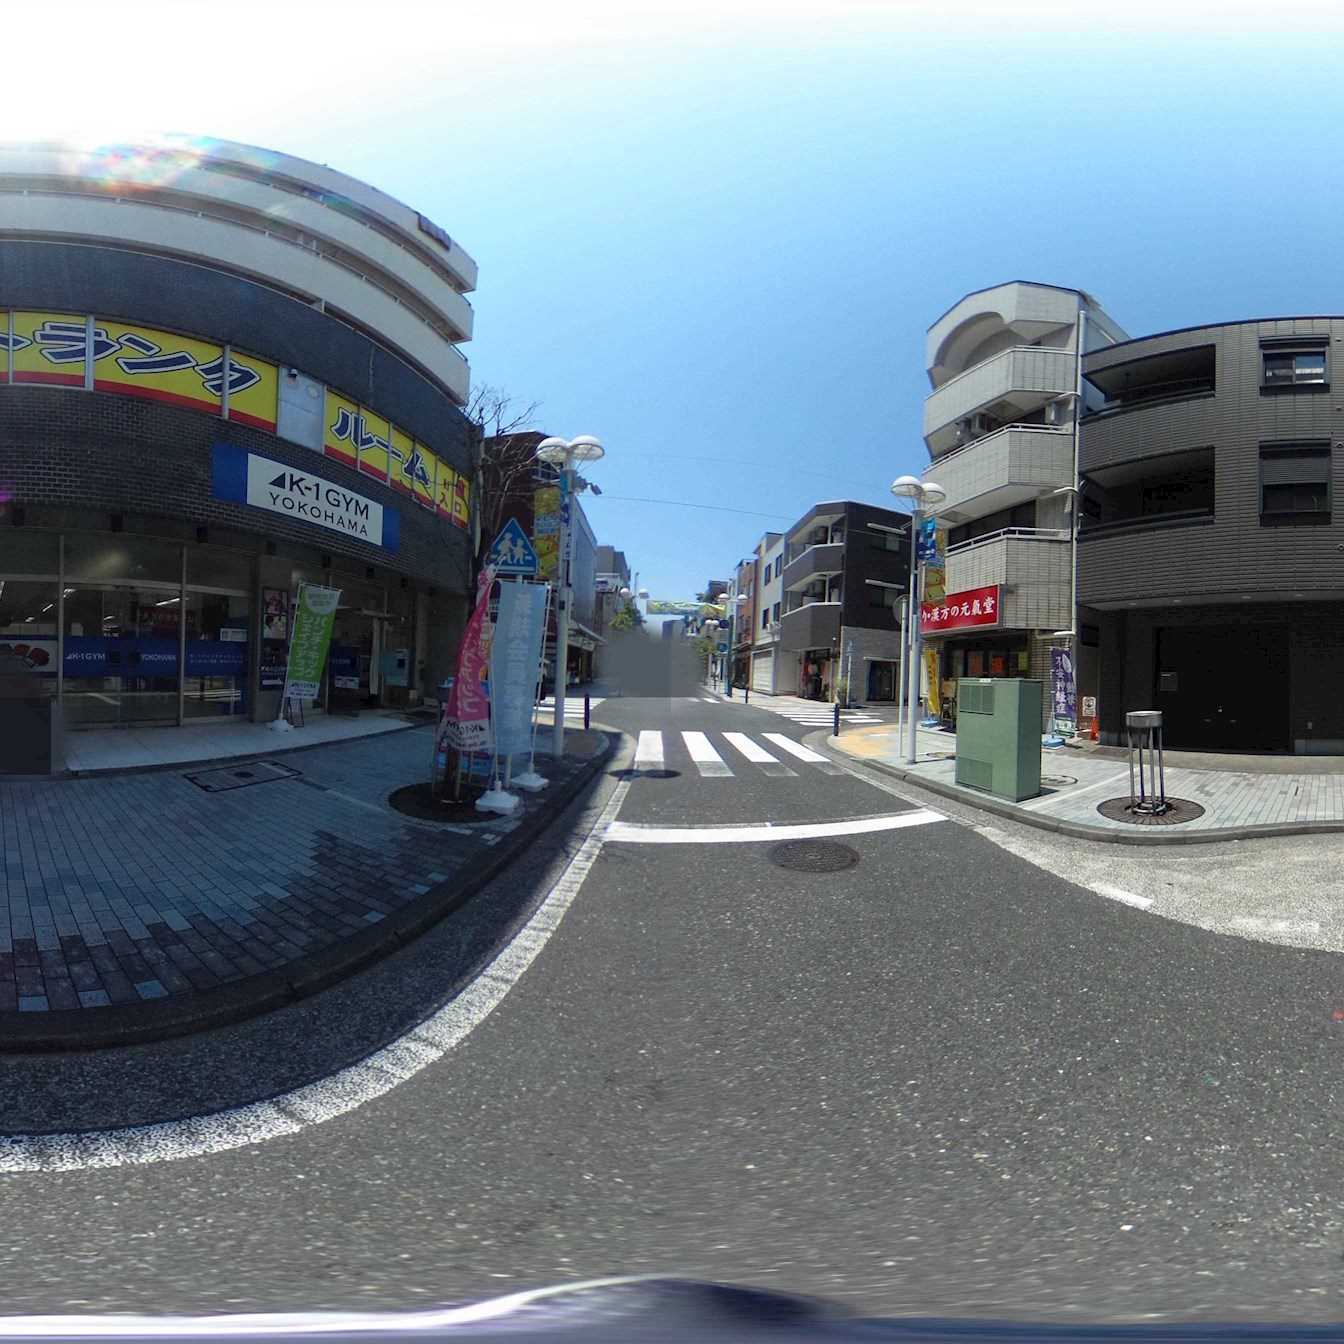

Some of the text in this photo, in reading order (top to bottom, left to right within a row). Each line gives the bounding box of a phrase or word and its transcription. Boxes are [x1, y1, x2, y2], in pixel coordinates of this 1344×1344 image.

[269, 491, 368, 537] YOKOHAMA
[289, 473, 369, 521] K-1 GYM
[920, 595, 995, 624] り・漢方の元氣堂
